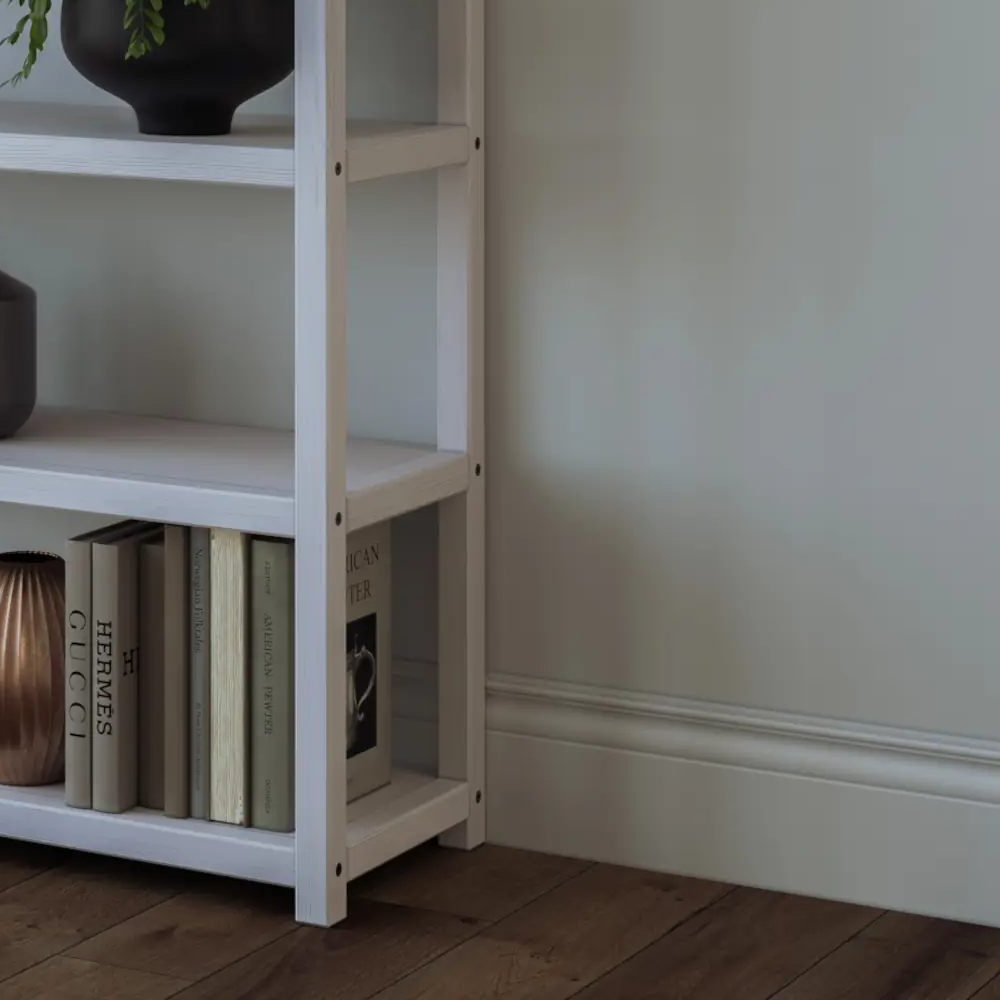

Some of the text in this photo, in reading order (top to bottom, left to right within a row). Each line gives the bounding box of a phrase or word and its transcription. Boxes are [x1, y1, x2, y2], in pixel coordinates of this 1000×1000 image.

[192, 547, 204, 605] Norwegian
[68, 609, 87, 739] GUCCI
[262, 612, 274, 736] AMERICAN PEWTER
